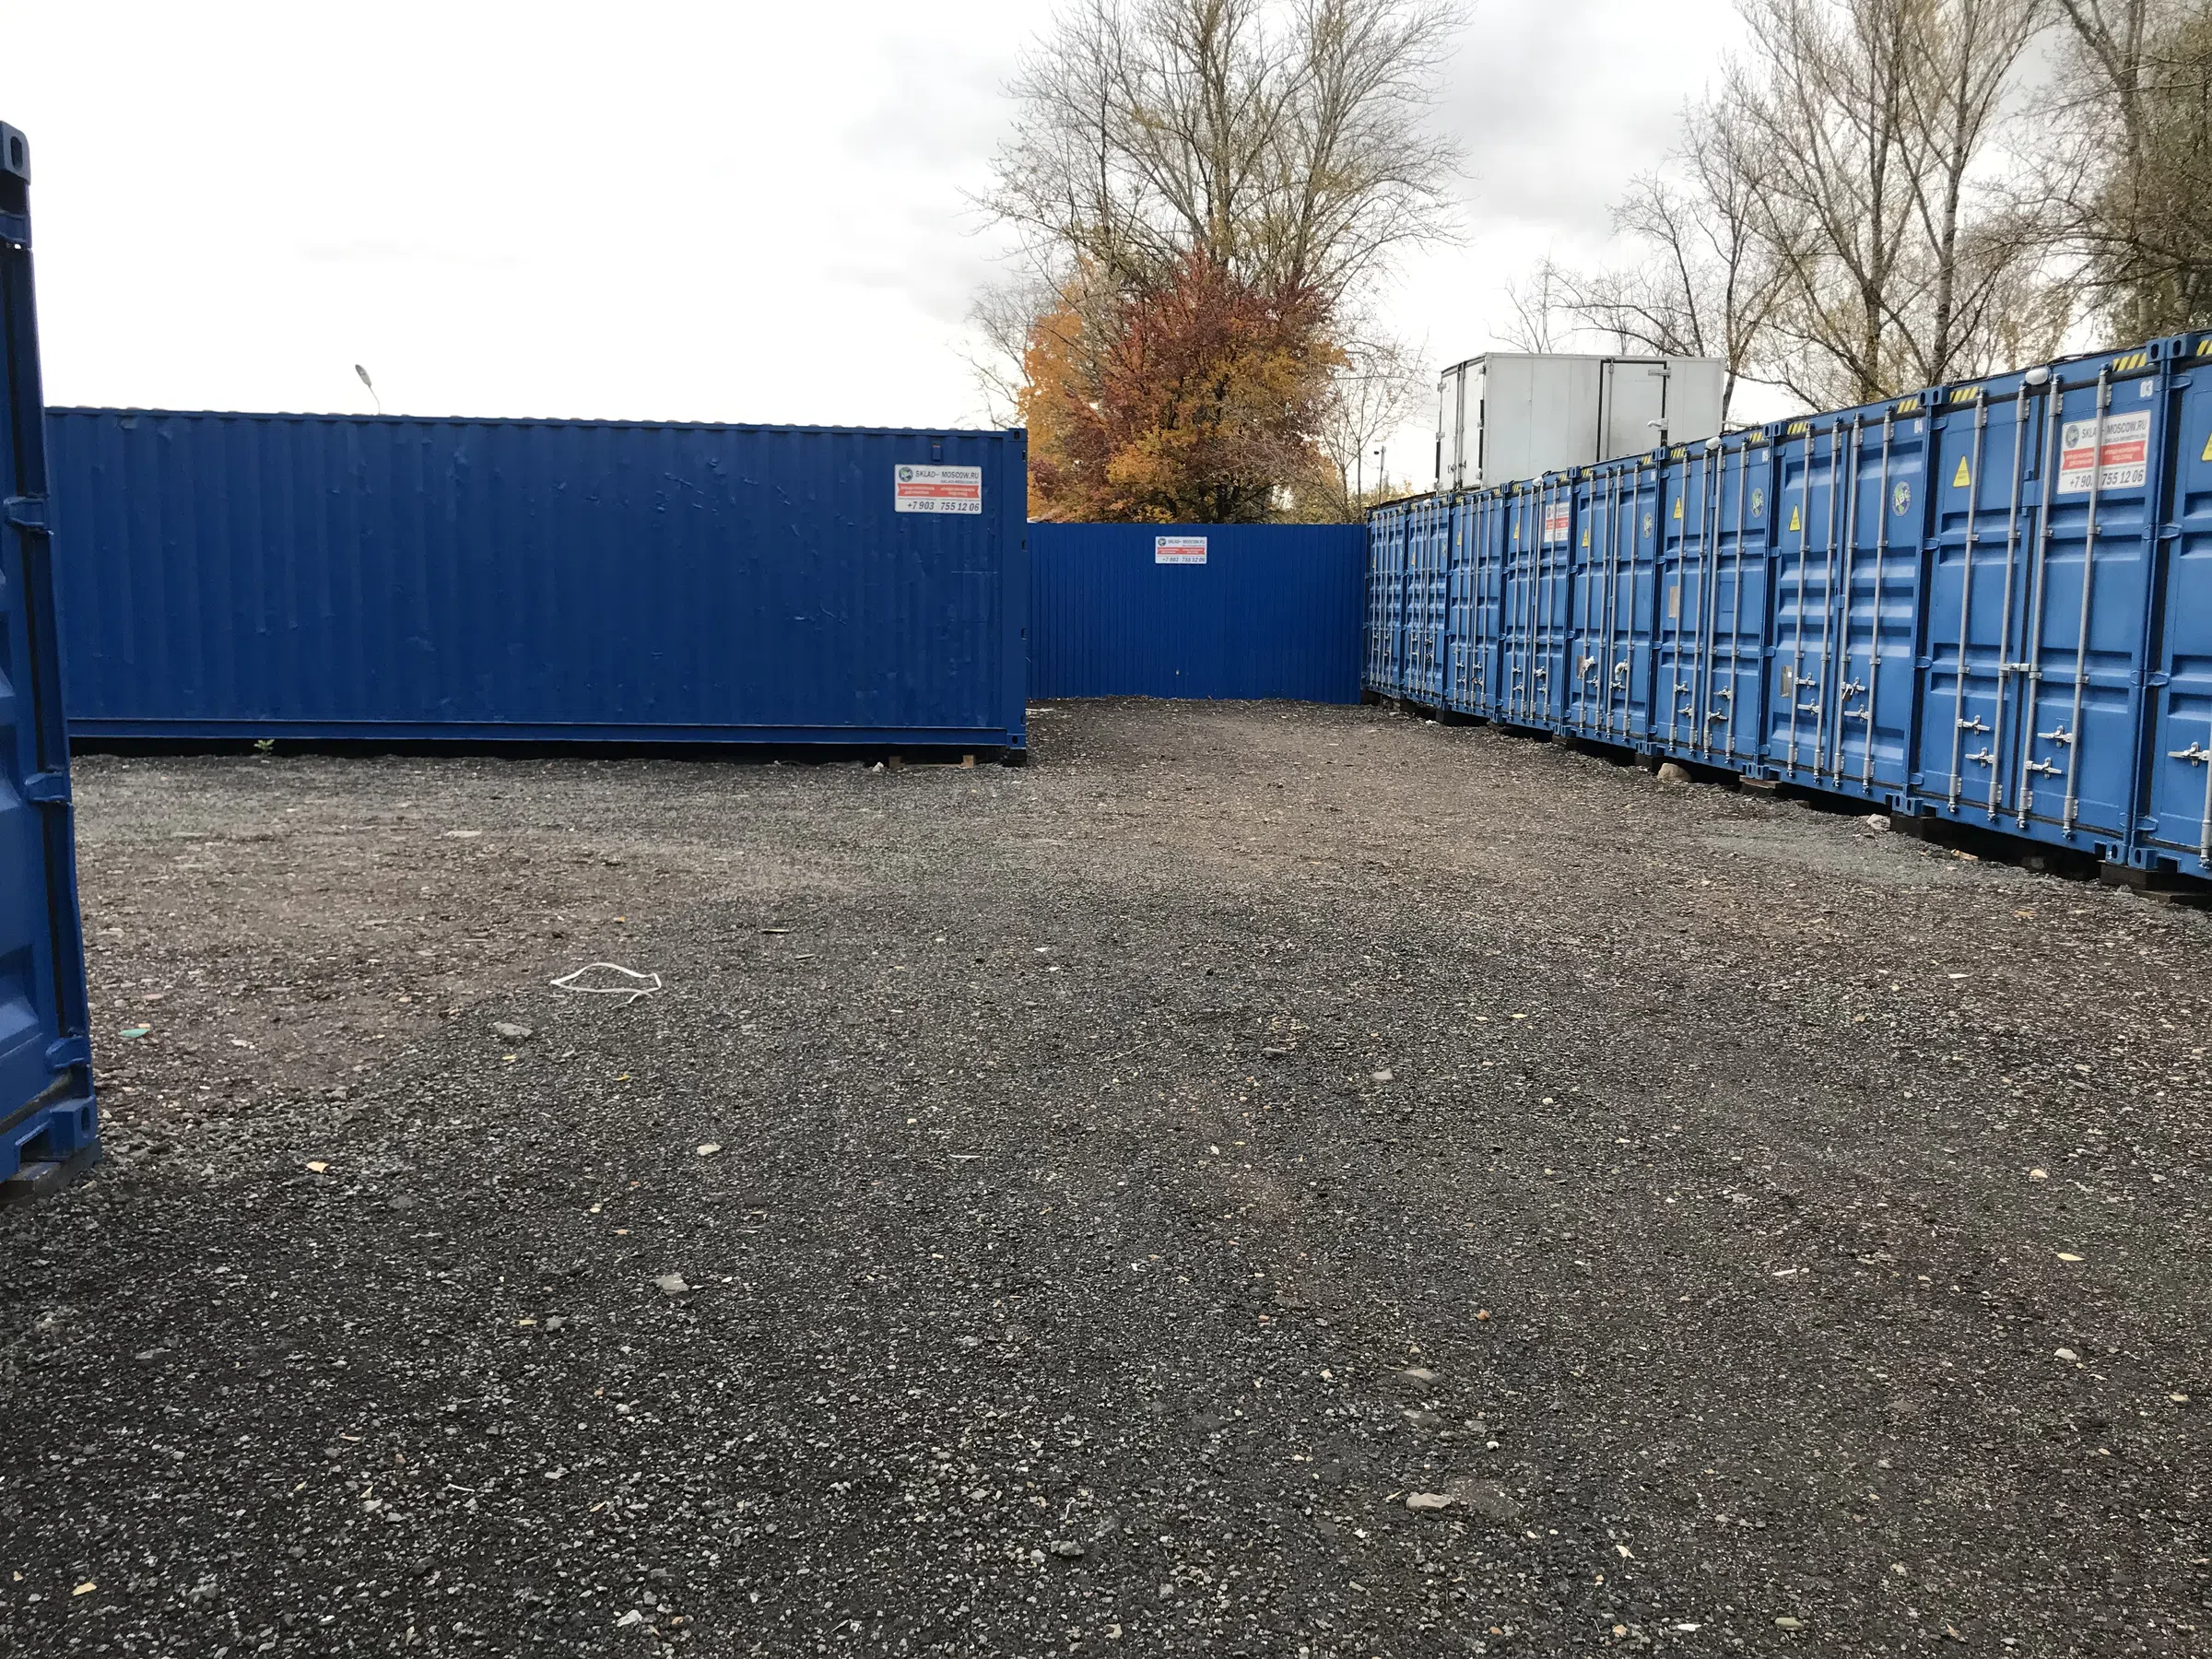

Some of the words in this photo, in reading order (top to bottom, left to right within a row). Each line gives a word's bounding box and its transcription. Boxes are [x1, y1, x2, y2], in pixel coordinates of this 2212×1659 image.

[2140, 380, 2153, 397] 03
[2106, 420, 2147, 435] MOSCOW.RU
[2069, 476, 2080, 489] +7
[2081, 475, 2093, 488] 90
[2101, 471, 2118, 485] 755
[2120, 470, 2131, 483] 12
[2132, 469, 2144, 482] 06
[907, 501, 918, 510] +7
[919, 501, 935, 510] 903
[941, 502, 956, 511] 755
